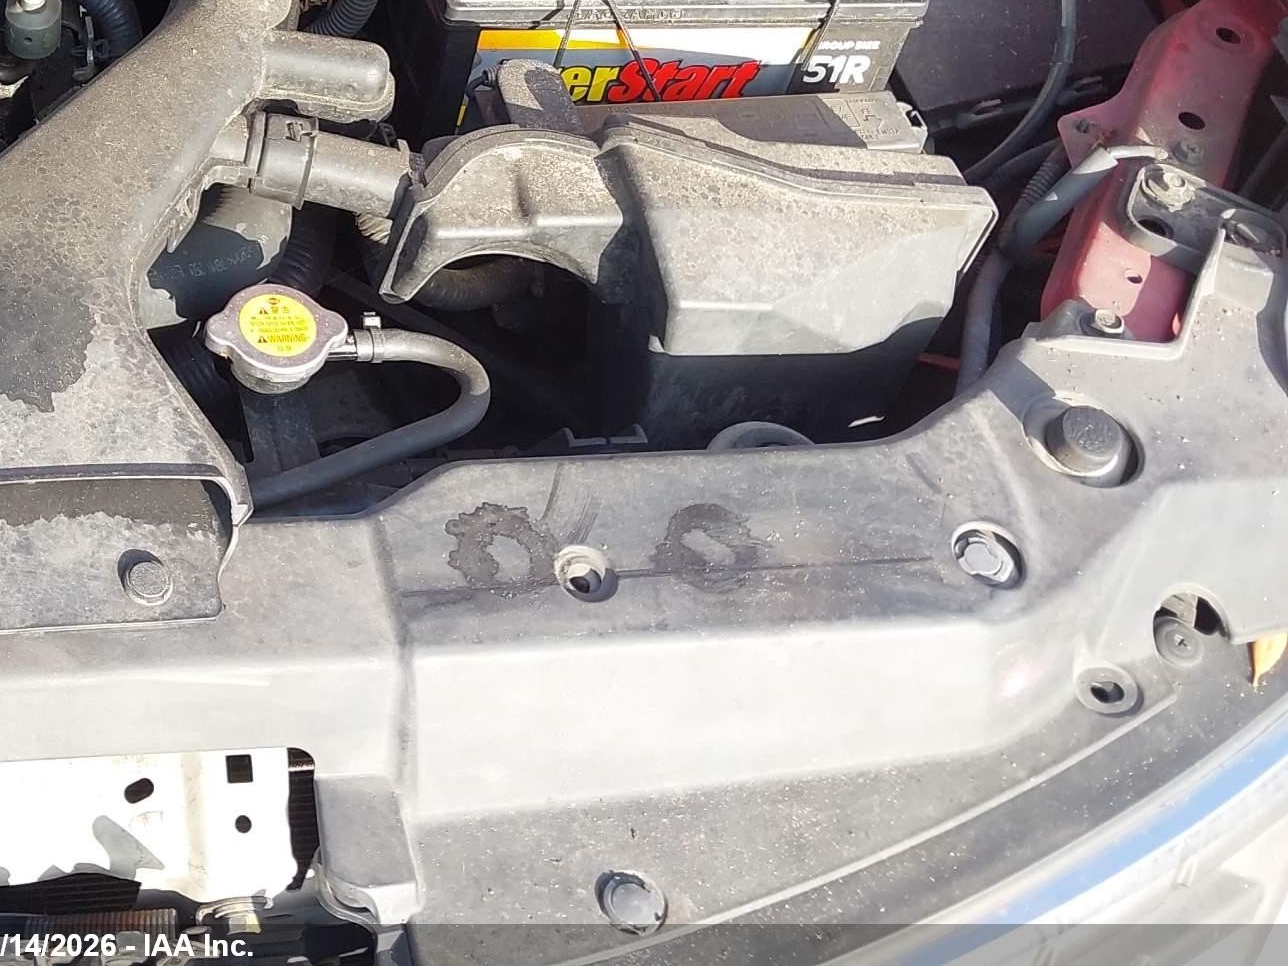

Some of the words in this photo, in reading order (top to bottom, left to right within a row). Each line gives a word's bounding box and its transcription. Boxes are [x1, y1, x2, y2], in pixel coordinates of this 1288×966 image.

[855, 40, 881, 50] SIZE
[803, 53, 871, 84] 51R
[558, 57, 762, 103] erStart
[267, 333, 307, 343] WARNING
